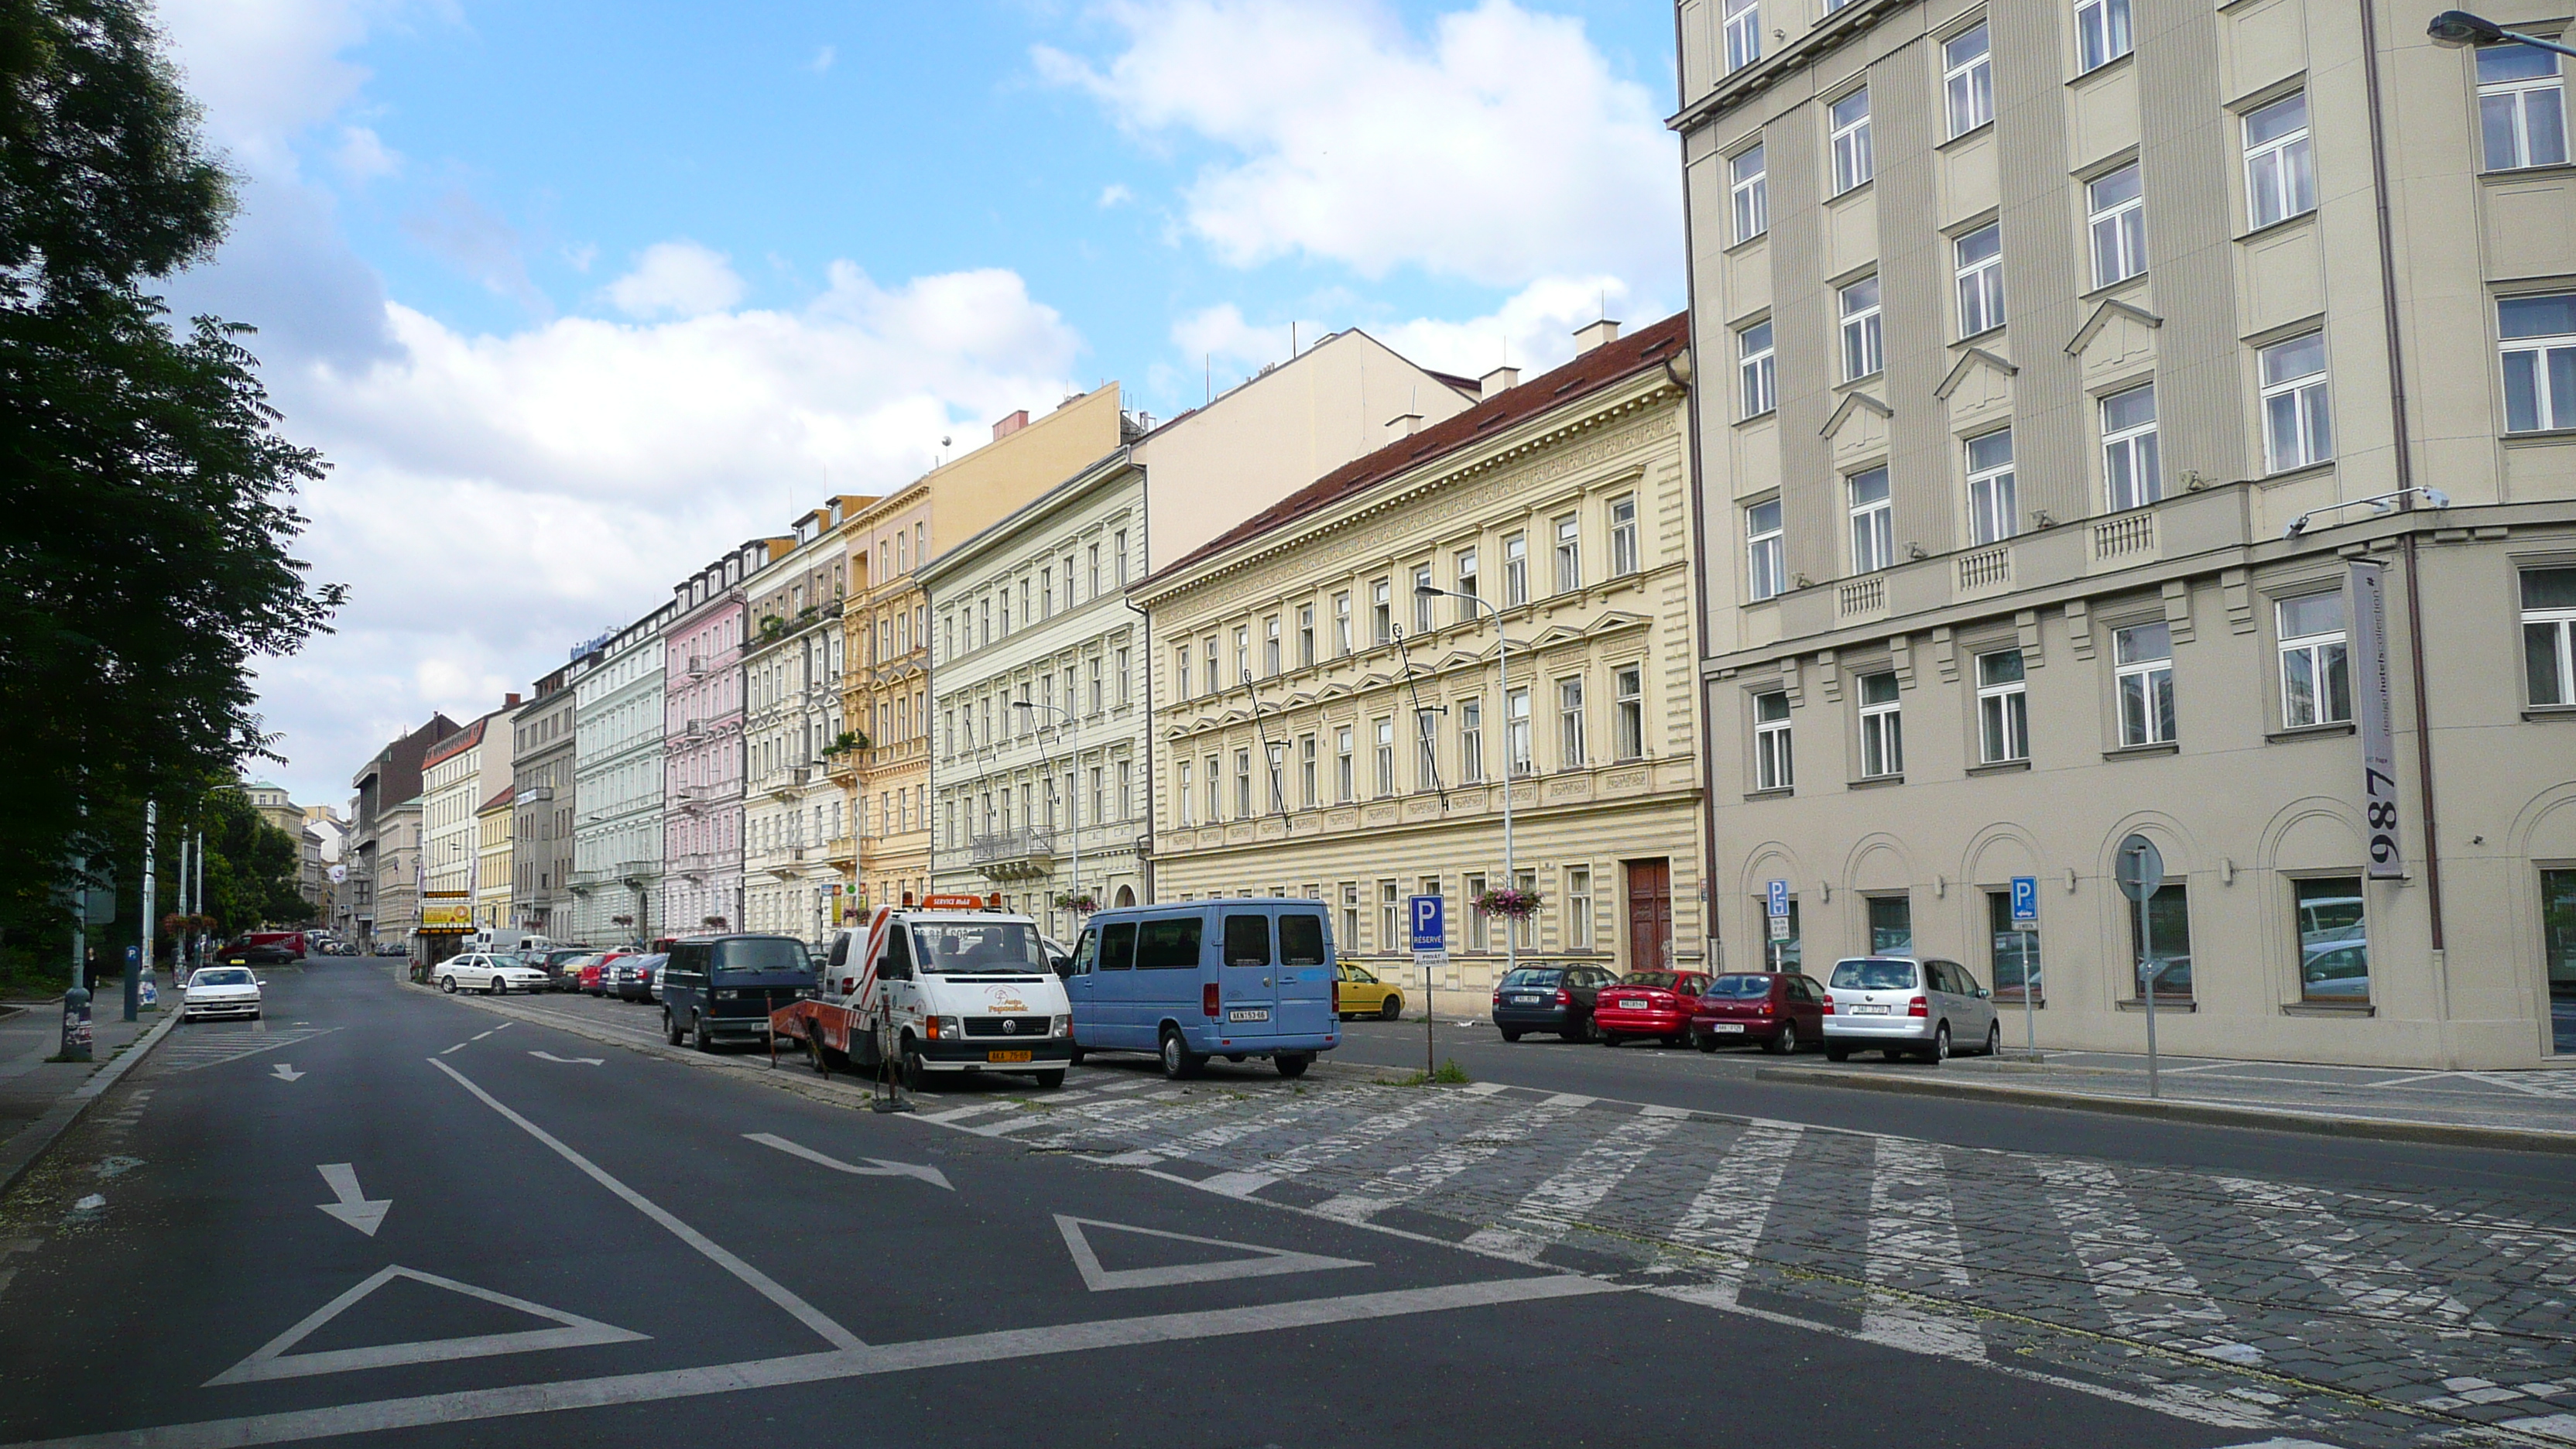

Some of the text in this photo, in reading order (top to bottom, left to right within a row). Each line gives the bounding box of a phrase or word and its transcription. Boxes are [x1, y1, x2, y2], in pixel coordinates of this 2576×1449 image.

[2365, 767, 2400, 864] 987
[1772, 882, 1783, 903] P
[2016, 882, 2031, 906] P
[1418, 900, 1436, 931] P
[1414, 934, 1442, 944] RÉSERVÉ
